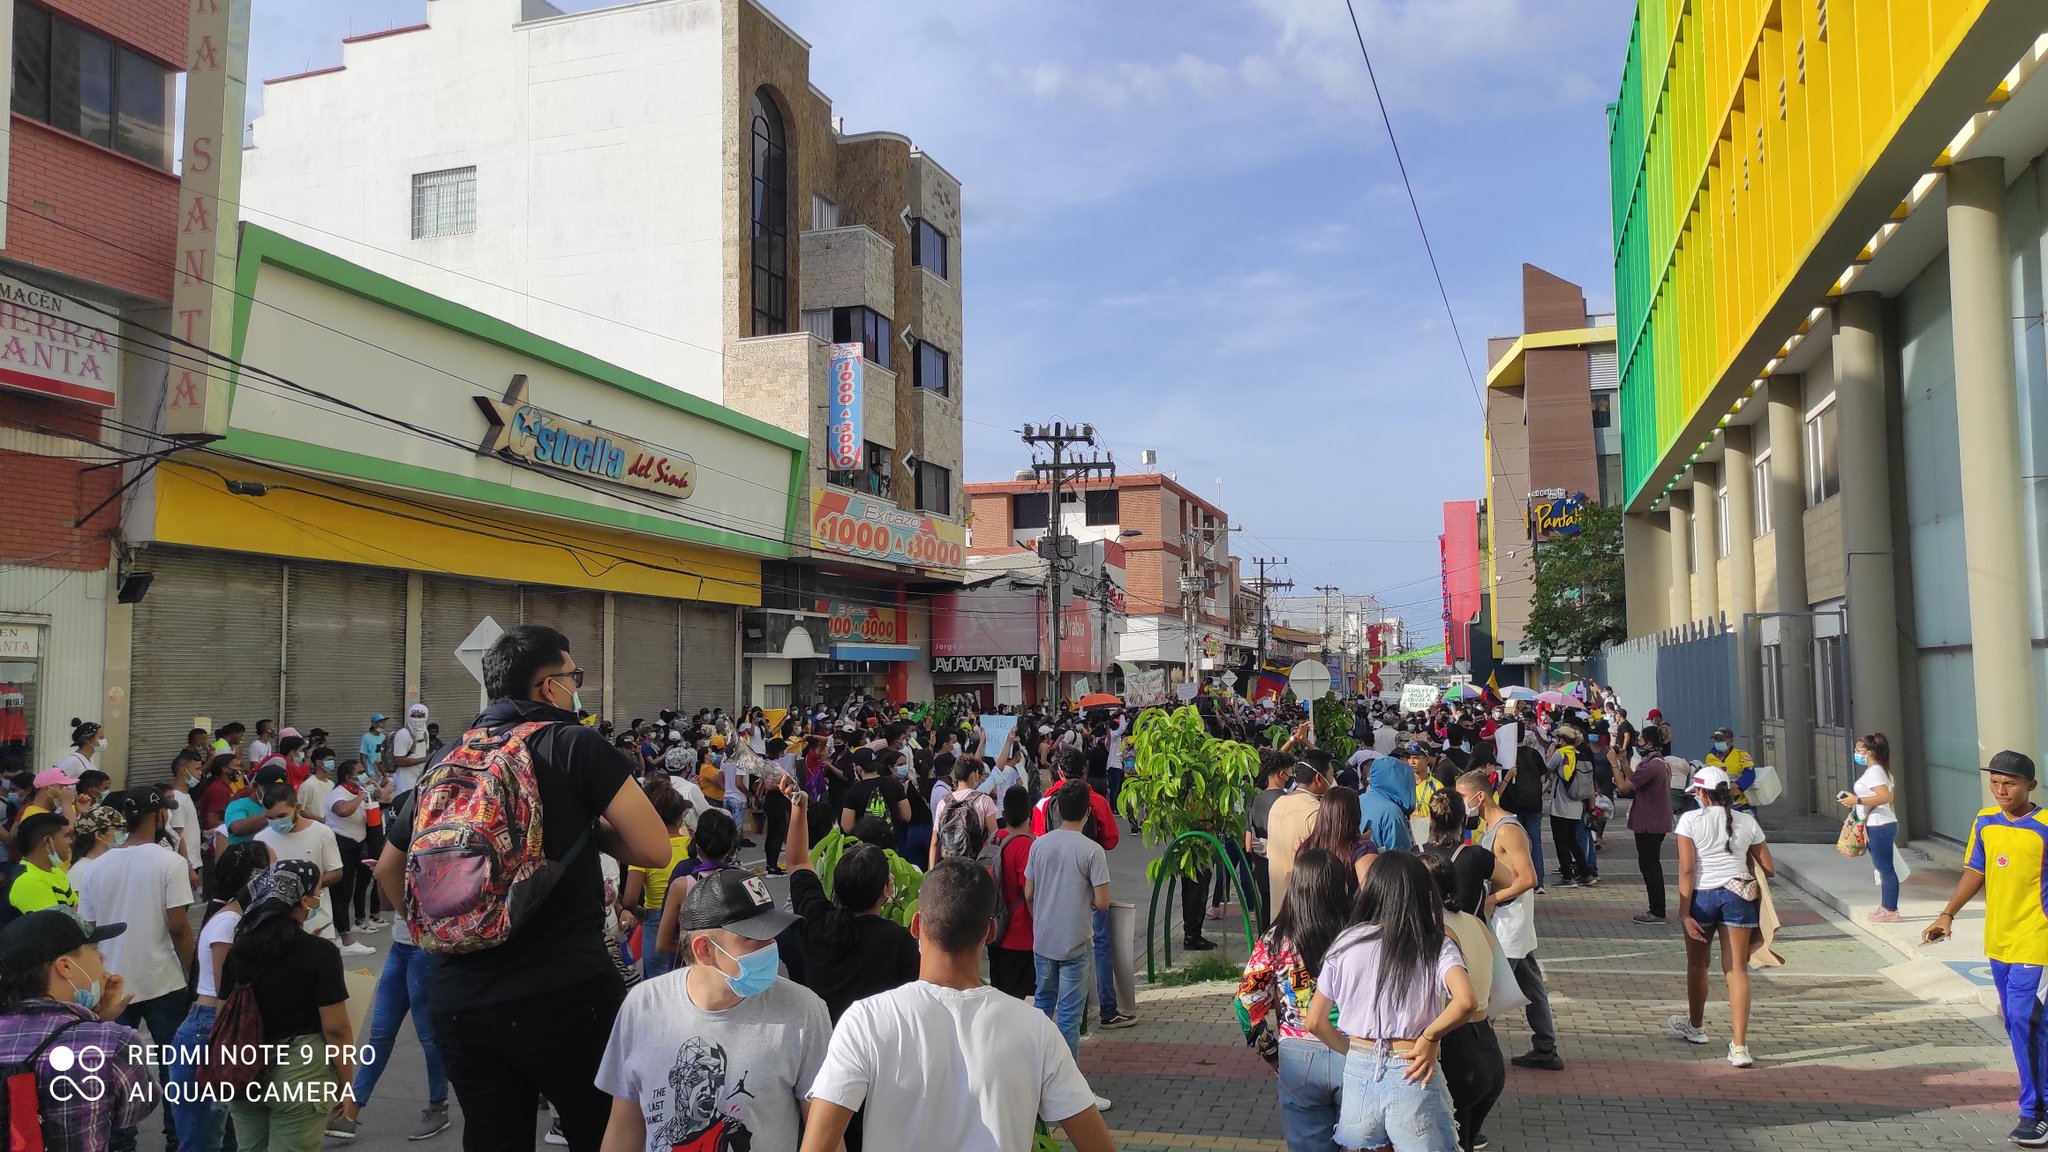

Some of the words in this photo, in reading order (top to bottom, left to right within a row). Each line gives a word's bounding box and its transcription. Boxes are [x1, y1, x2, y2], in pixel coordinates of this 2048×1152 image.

[168, 137, 213, 410] SANTA
[0, 336, 104, 381] ANTA
[628, 453, 652, 480] del
[864, 503, 921, 529] Exitazo
[819, 514, 890, 553] $1000
[895, 536, 903, 549] A
[908, 533, 961, 567] $3000
[0, 641, 30, 653] NTA
[935, 642, 956, 652] Jorge
[648, 1100, 664, 1112] LAST
[652, 1087, 666, 1099] THE
